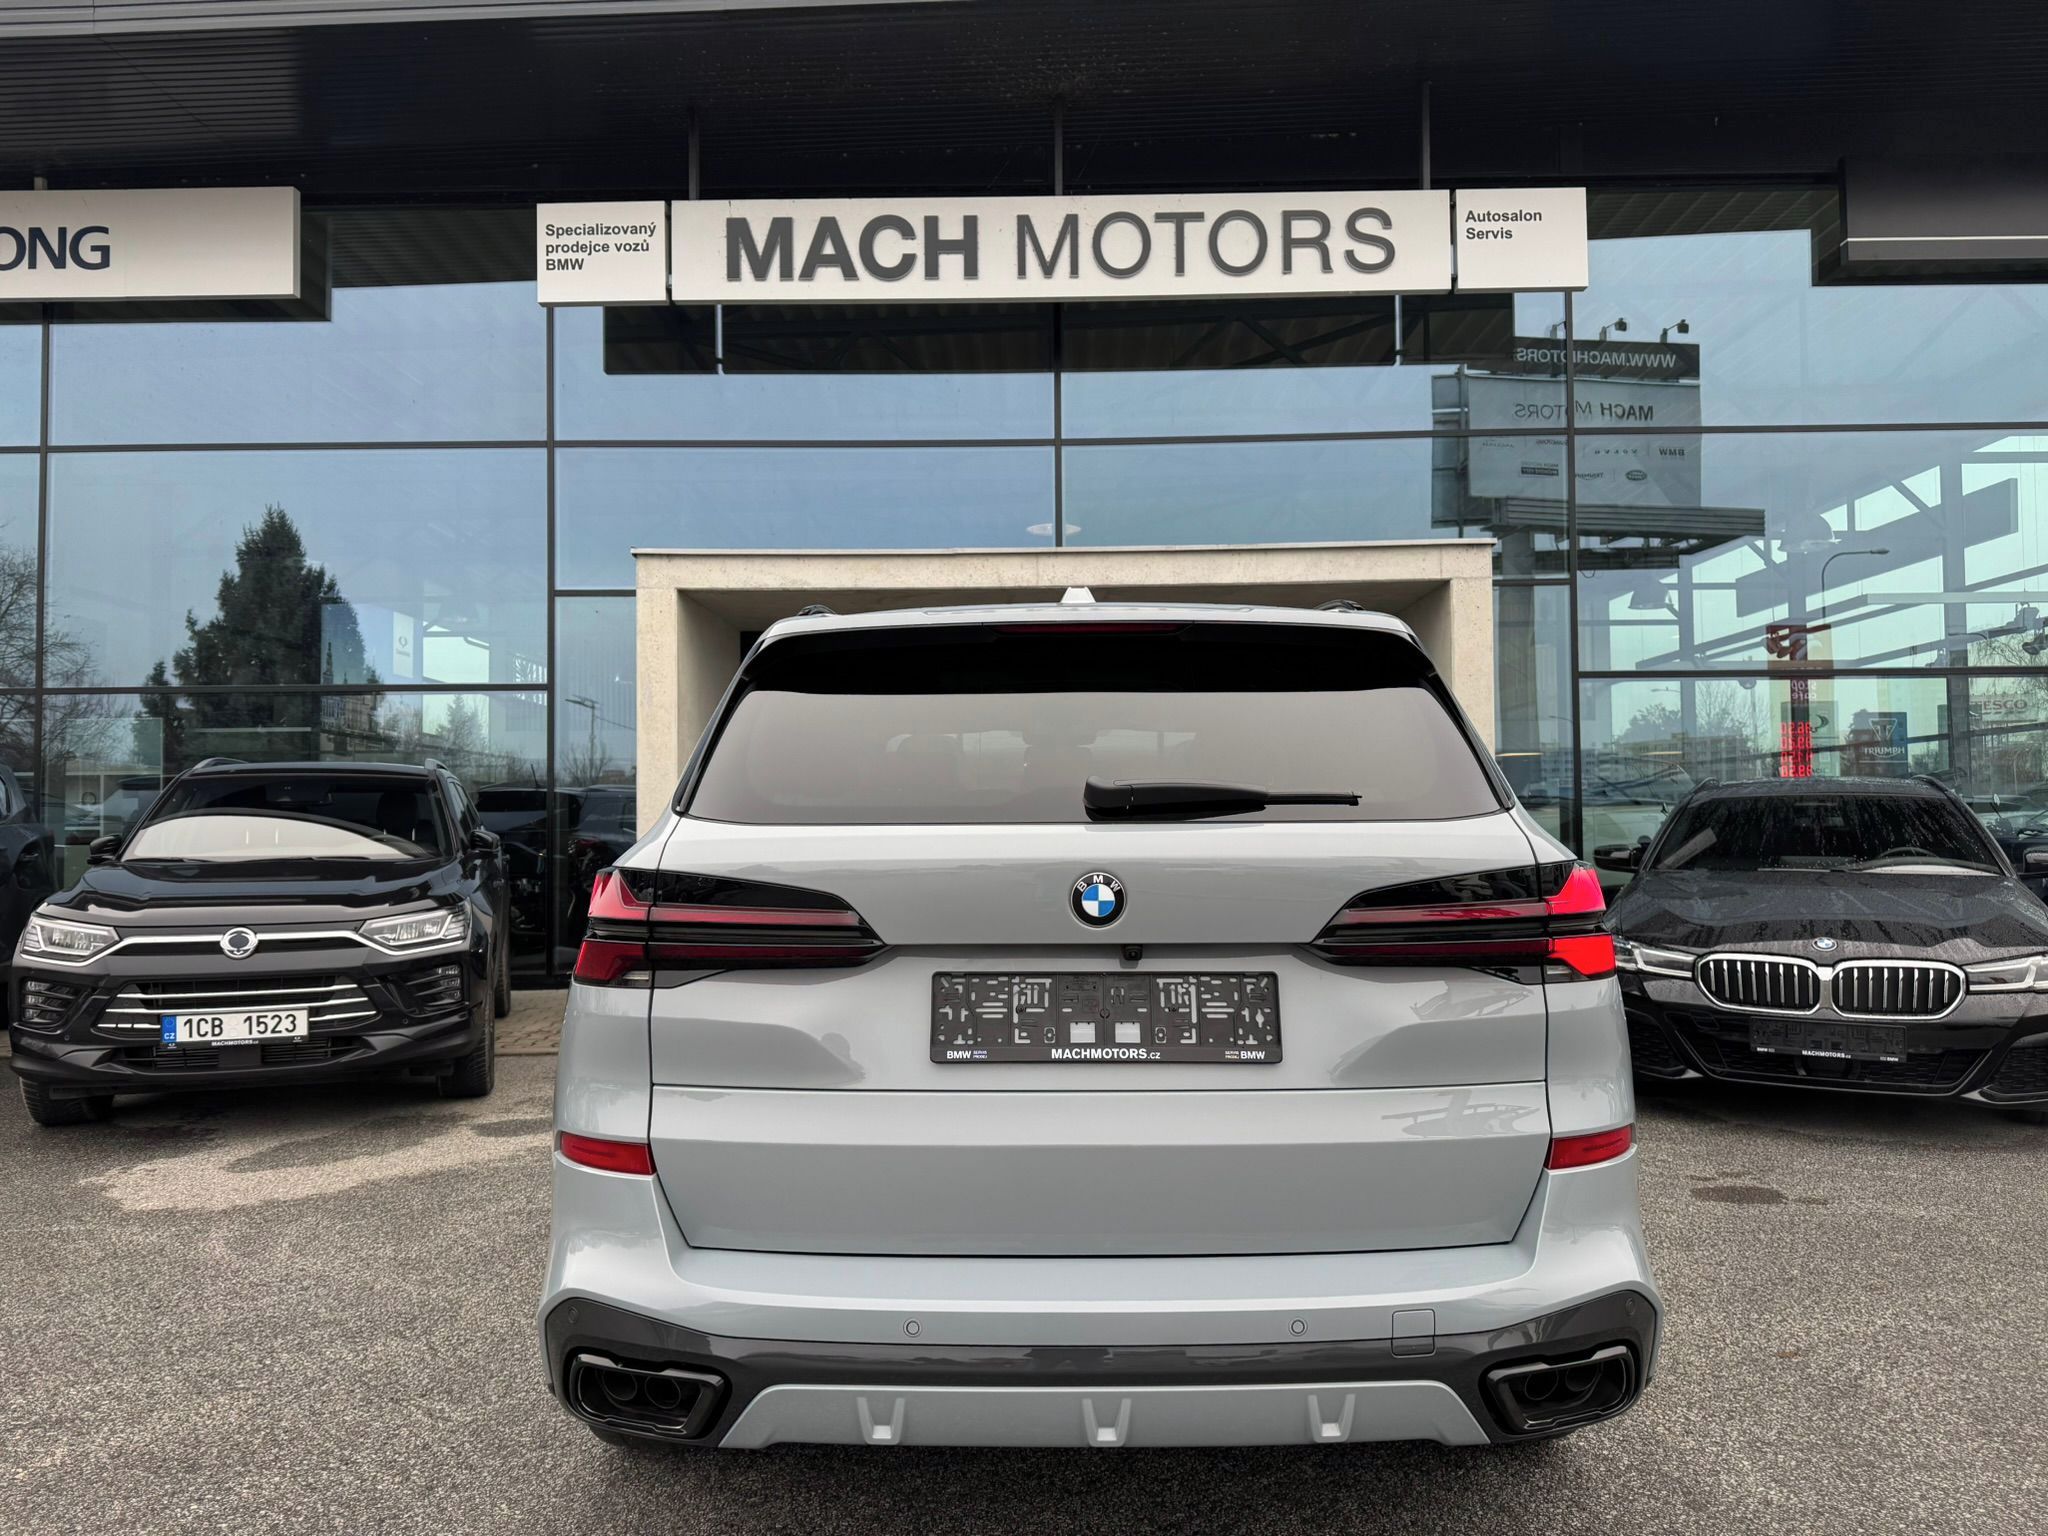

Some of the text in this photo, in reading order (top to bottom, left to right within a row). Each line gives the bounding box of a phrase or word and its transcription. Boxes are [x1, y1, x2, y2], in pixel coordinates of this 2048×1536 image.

[1465, 209, 1542, 223] Autosalon
[545, 221, 656, 239] Specializovaný
[1466, 226, 1513, 240] Servis
[546, 239, 650, 256] prodejce vozů
[726, 207, 1396, 282] MACH MOTORS
[546, 258, 584, 271] BMW
[1864, 746, 1905, 756] TRIUMPH
[1077, 875, 1120, 892] BMW
[183, 1014, 297, 1039] 1CB 1523
[946, 1050, 971, 1059] BMW
[1051, 1048, 1161, 1060] MACHMOTORS.cz
[1240, 1051, 1265, 1059] BMW
